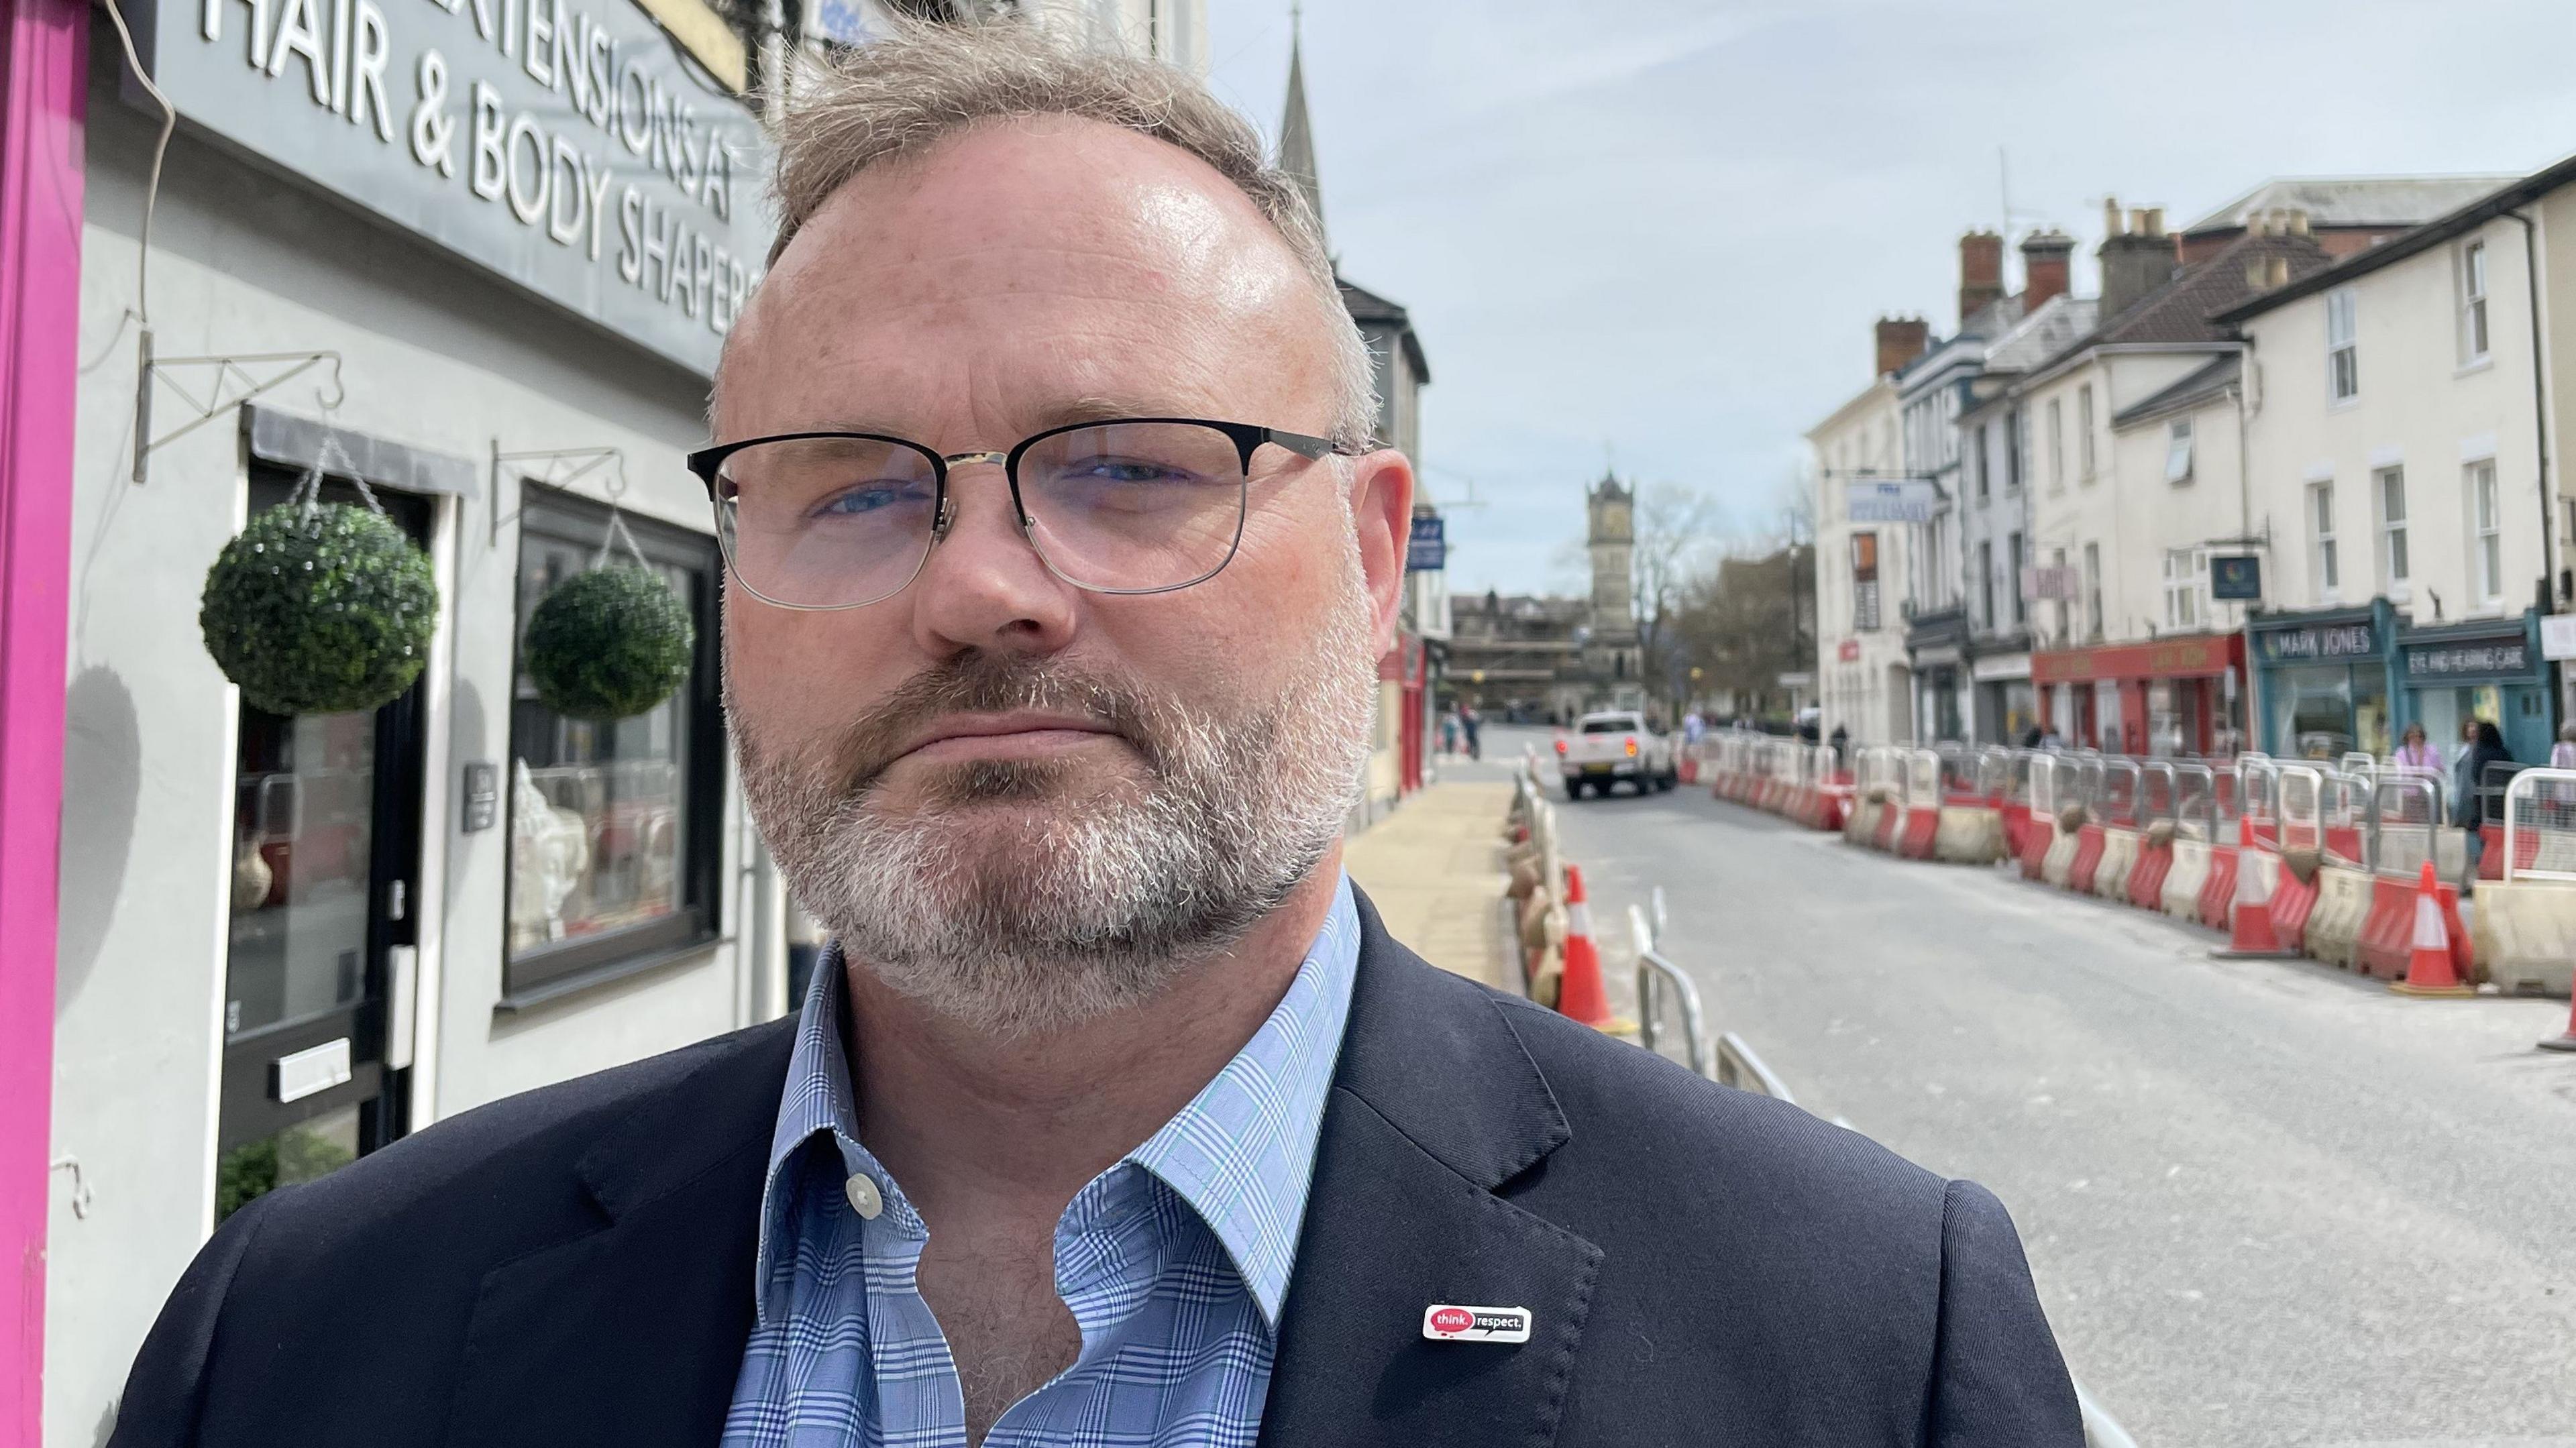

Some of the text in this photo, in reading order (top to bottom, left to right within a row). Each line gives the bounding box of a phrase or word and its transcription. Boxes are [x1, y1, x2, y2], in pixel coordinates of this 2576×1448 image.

[421, 0, 697, 195] ENSIONS
[413, 49, 456, 178] &
[475, 78, 611, 260] BODY
[620, 183, 758, 335] SHAPER
[2280, 626, 2370, 657] MARK JONES
[1477, 1317, 1521, 1329] respect.
